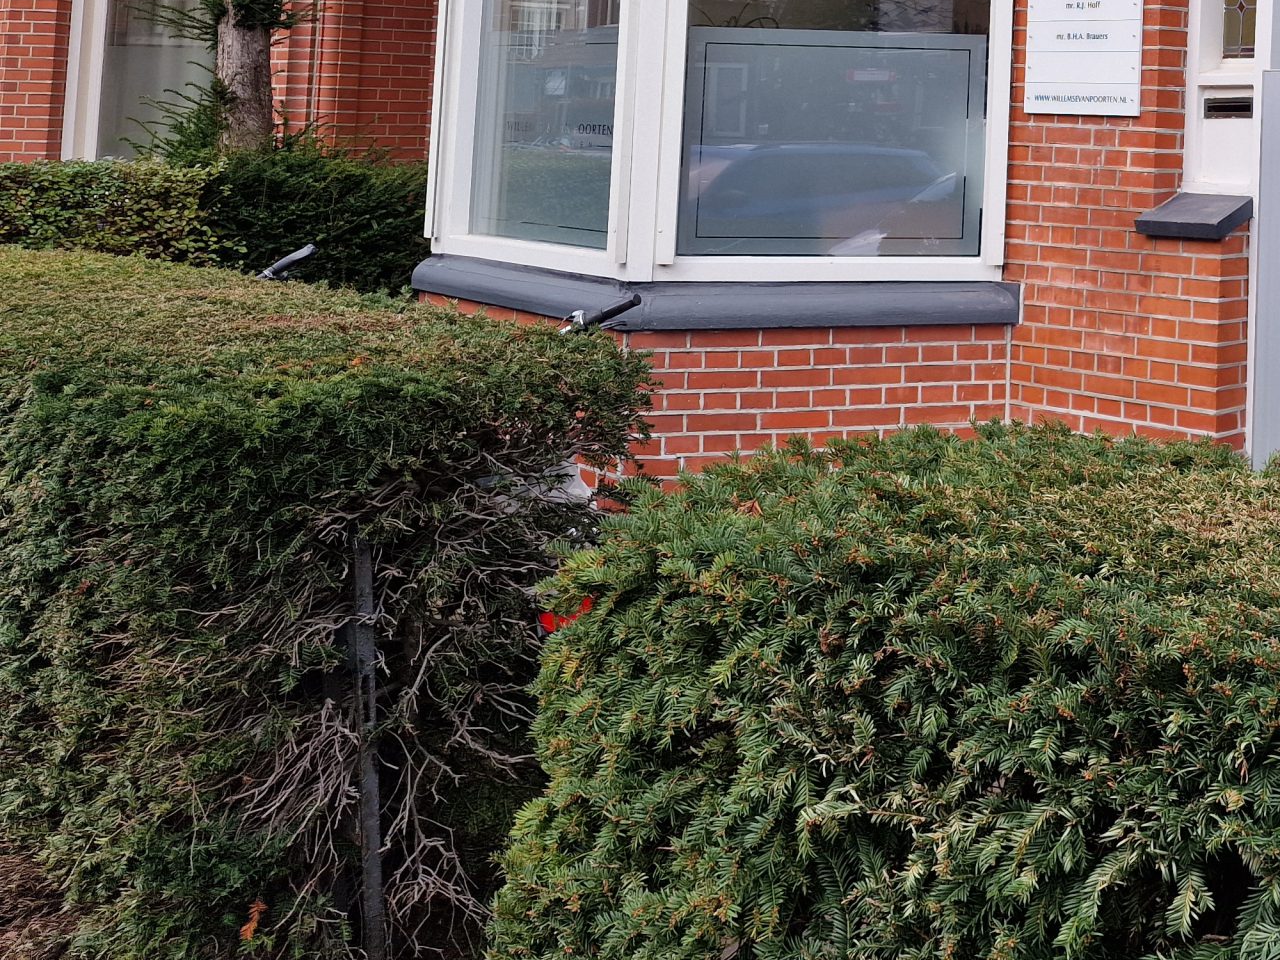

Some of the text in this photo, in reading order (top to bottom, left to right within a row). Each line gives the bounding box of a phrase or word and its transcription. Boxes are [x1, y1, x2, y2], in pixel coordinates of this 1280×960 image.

[1087, 0, 1101, 9] Hoff
[1086, 32, 1108, 40] Brauers
[1034, 94, 1128, 104] WWW.WILLEMSEVANPOORTEN.NL
